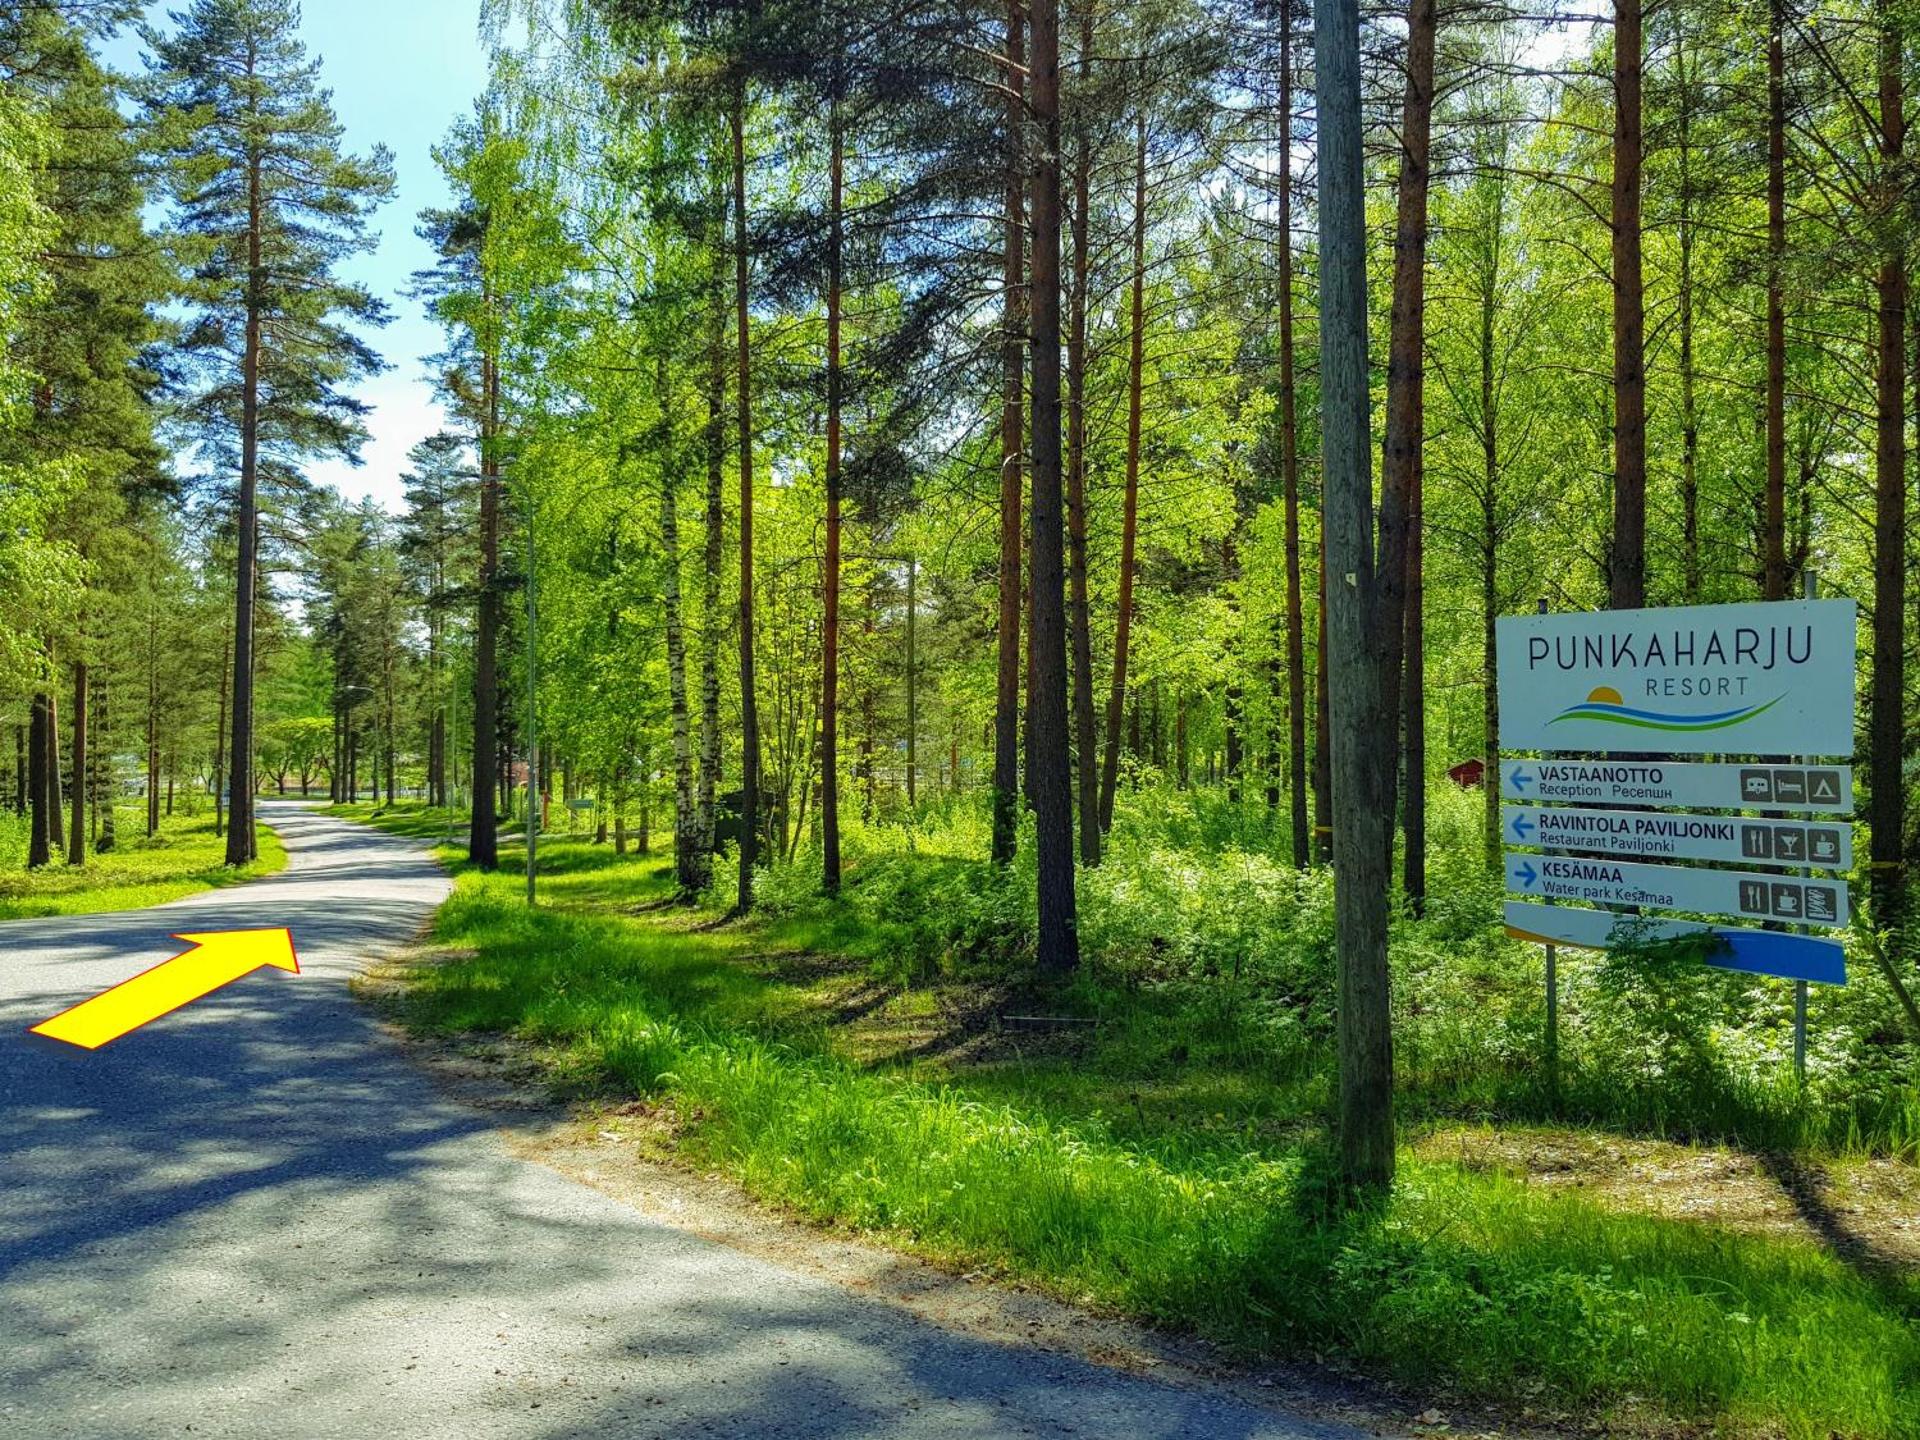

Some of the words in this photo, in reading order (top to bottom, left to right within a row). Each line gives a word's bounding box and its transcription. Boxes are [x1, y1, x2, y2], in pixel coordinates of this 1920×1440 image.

[1529, 625, 1812, 670] PUNKAHARJU
[1645, 676, 1749, 697] RESORT
[1538, 766, 1663, 784] VASTAANOTTO
[1539, 783, 1602, 798] Reception
[1539, 814, 1631, 834] RAVINTOLA
[1635, 819, 1735, 841] PAVILJONKI
[1539, 832, 1607, 848] Restaurant
[1610, 836, 1675, 853] Paviljonki
[1542, 861, 1624, 883] KESÄMAA
[1542, 881, 1580, 896] Water
[1583, 885, 1611, 899] park
